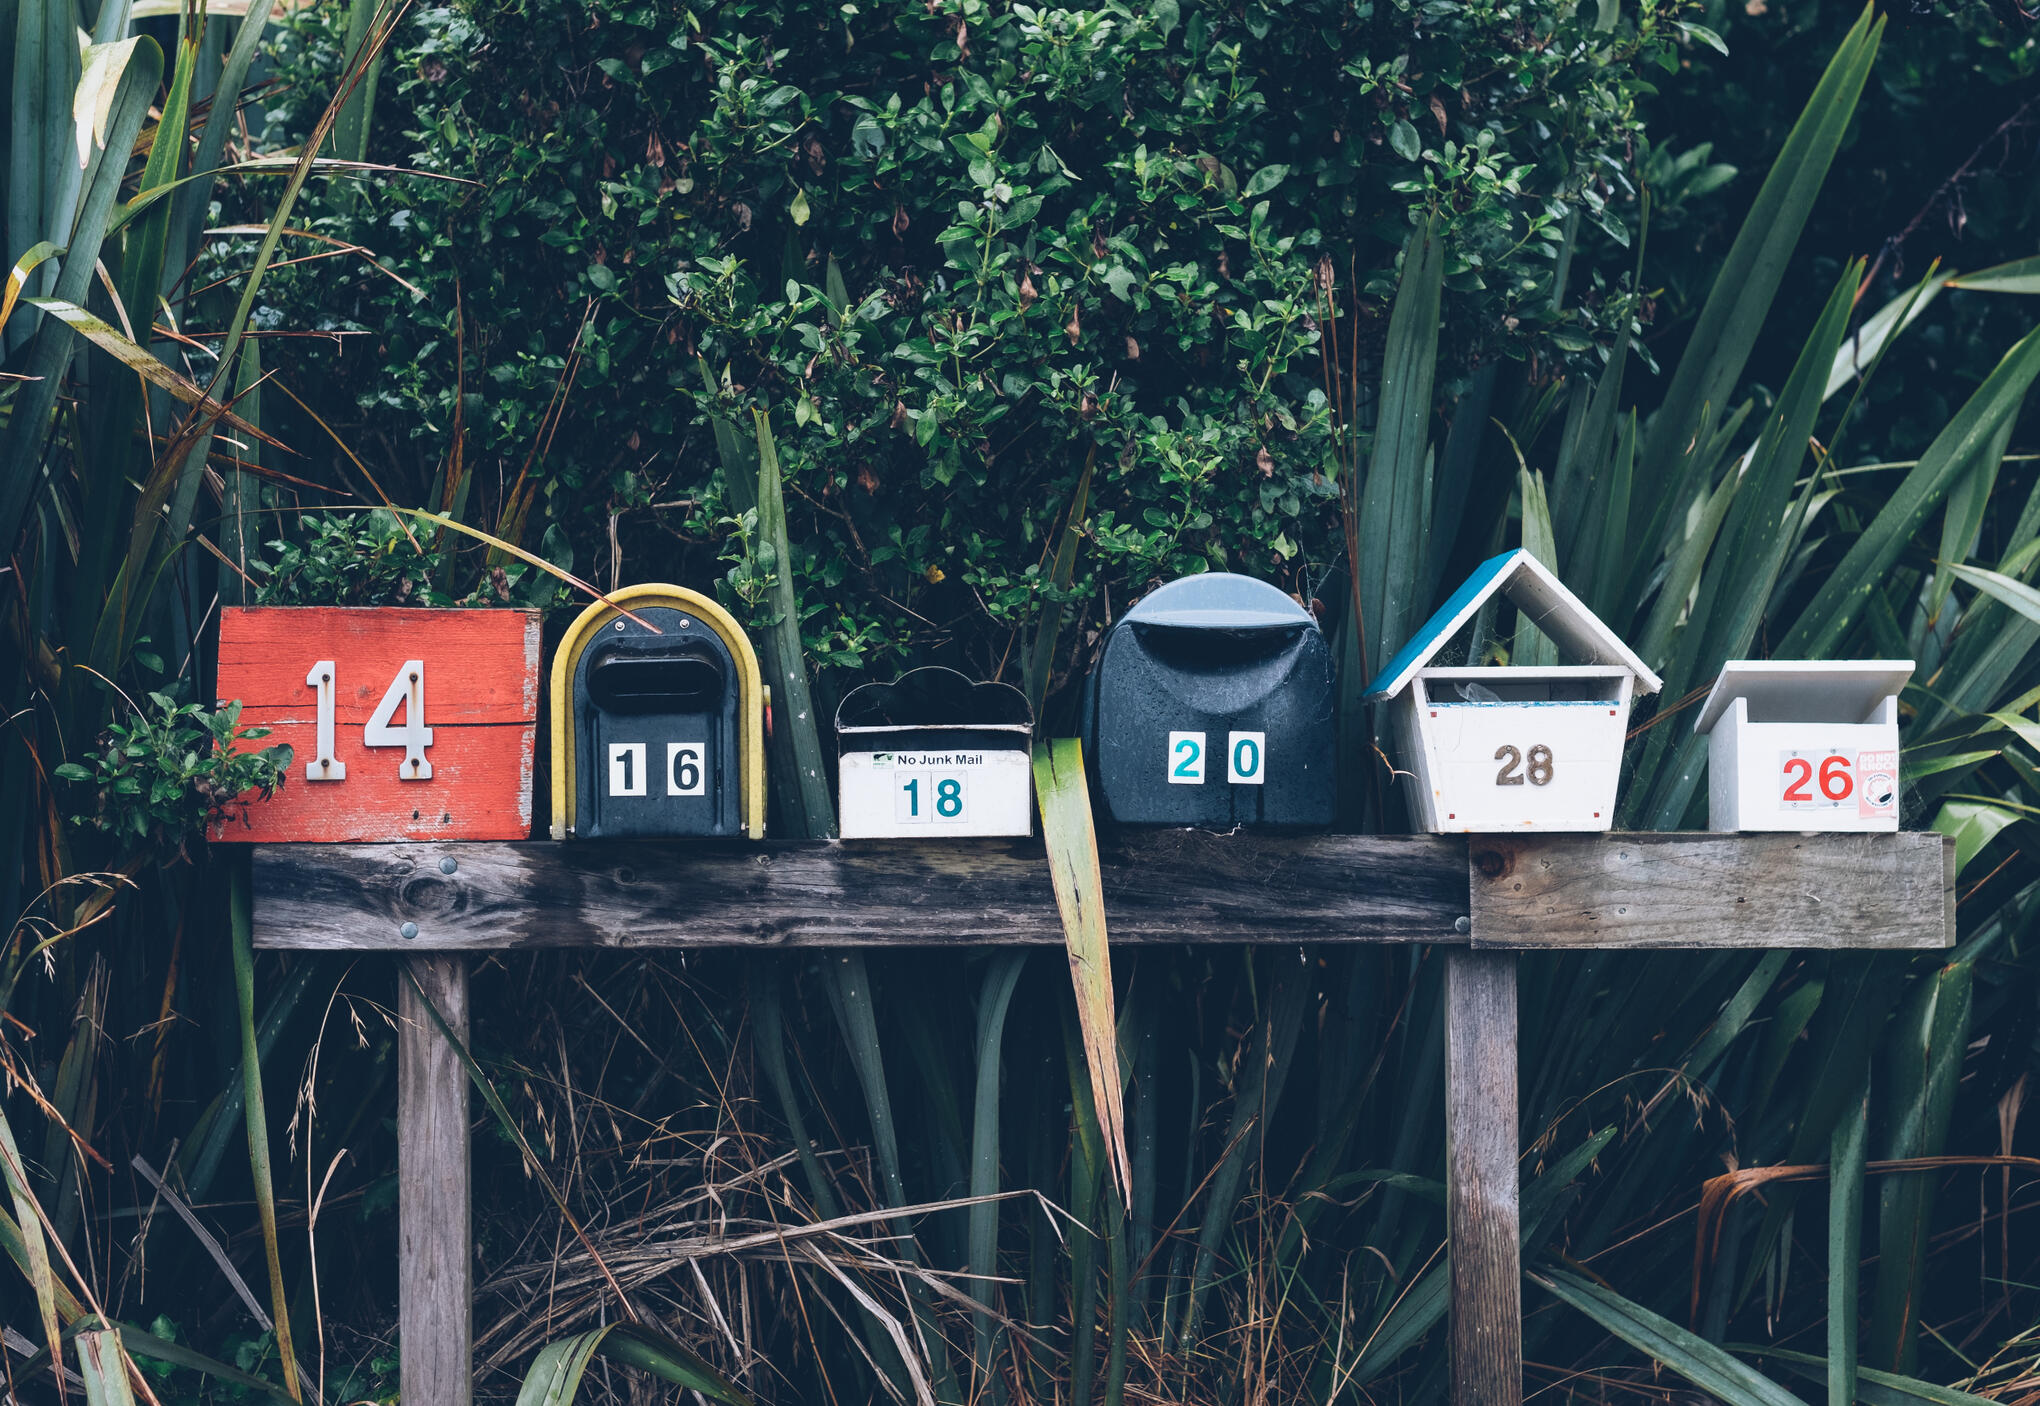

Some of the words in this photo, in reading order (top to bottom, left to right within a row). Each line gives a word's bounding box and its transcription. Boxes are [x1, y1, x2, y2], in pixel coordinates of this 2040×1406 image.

[306, 660, 434, 780] 14
[615, 748, 700, 790] 16
[898, 754, 916, 765] No
[919, 754, 952, 765] Junk
[956, 754, 983, 765] Mail
[1173, 738, 1260, 778] 20
[1494, 743, 1554, 786] 28
[1783, 755, 1853, 801] 26
[903, 778, 963, 817] 18
